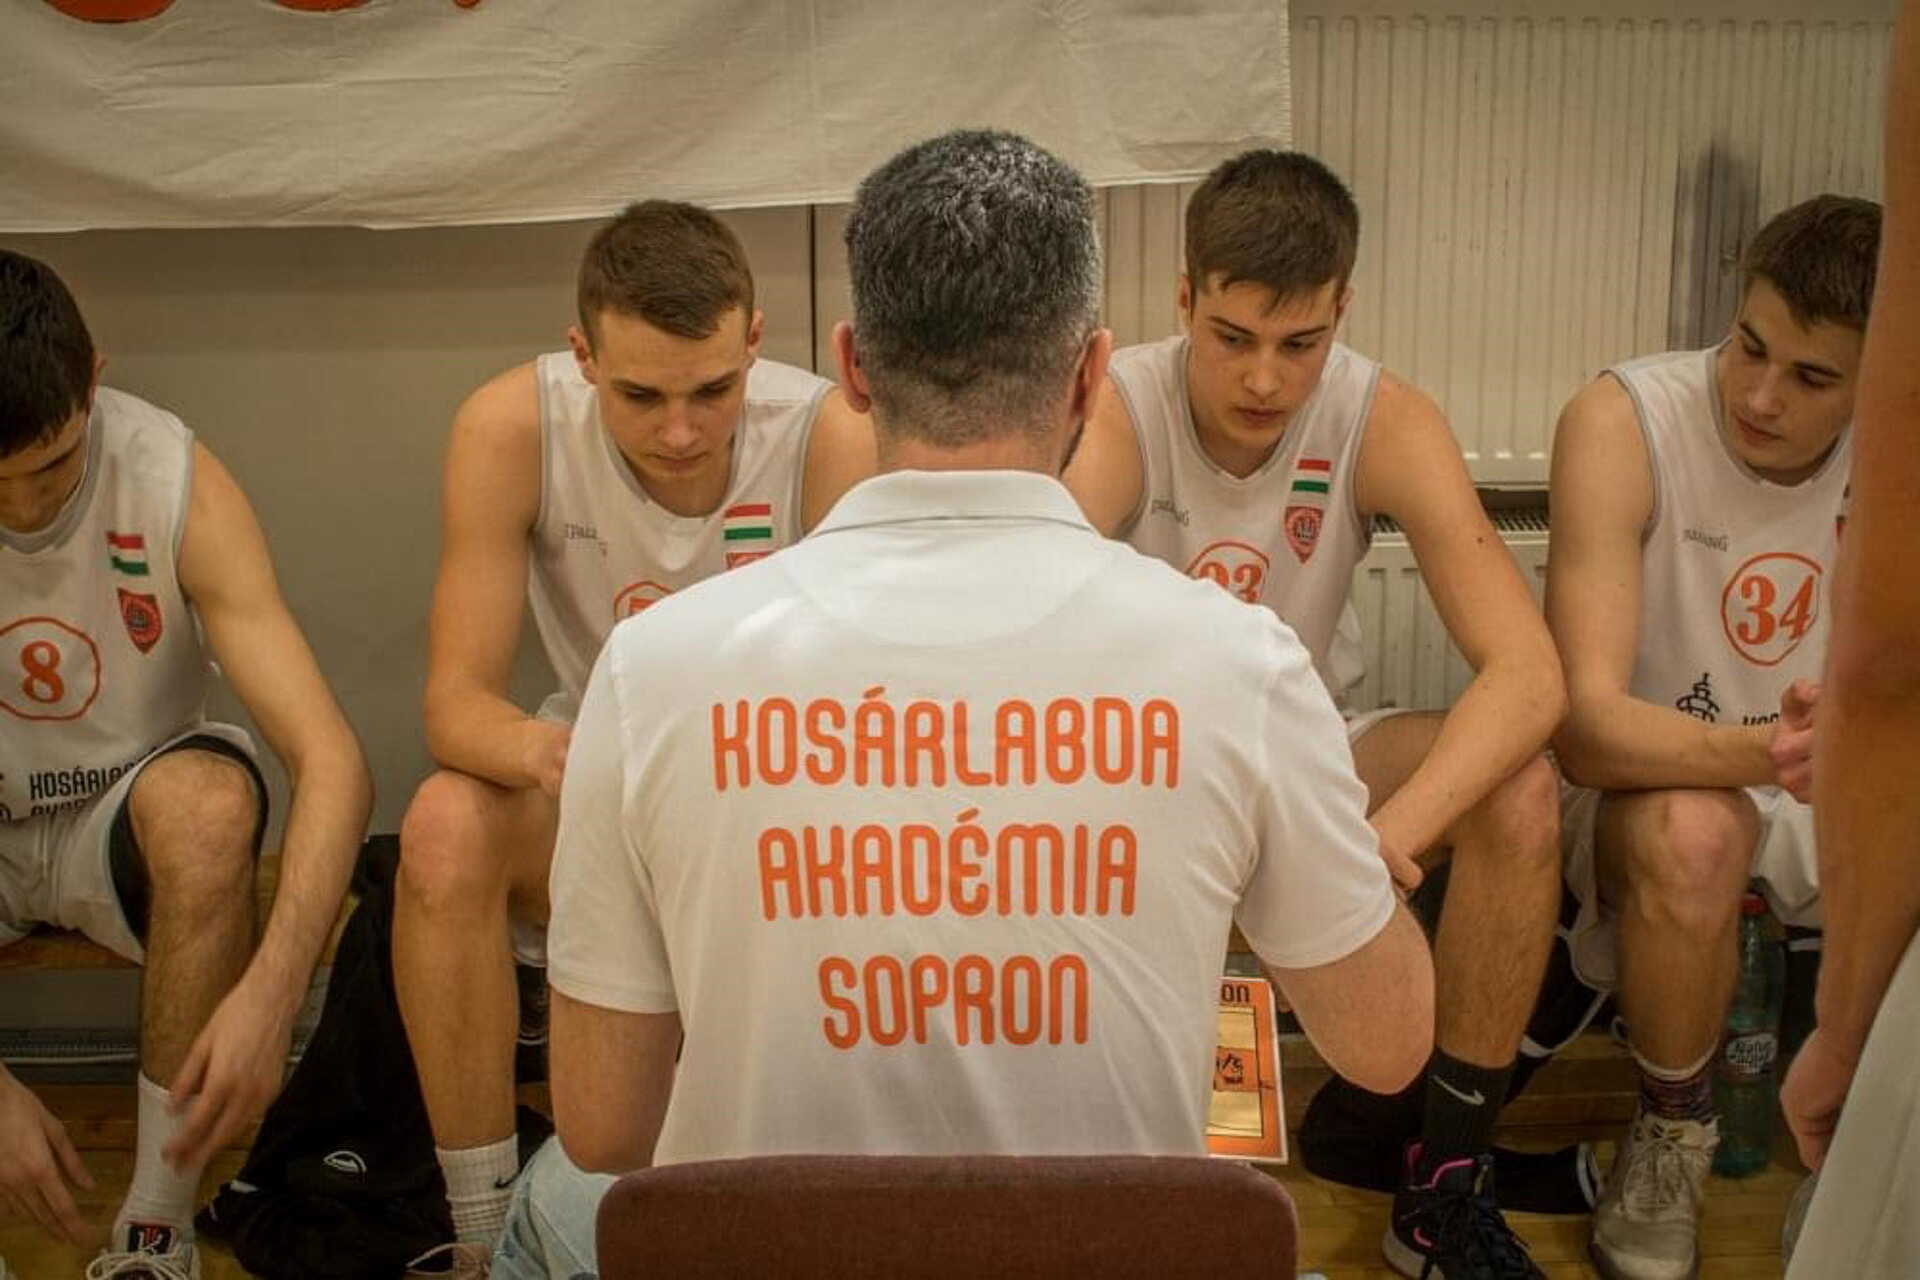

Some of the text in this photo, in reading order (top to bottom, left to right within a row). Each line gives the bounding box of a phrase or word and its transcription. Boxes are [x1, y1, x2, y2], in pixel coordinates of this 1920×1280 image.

[1736, 574, 1815, 646] 34
[20, 640, 65, 703] 8
[712, 687, 1179, 791] KOSÁRLABDA
[758, 808, 1137, 921] AKADÉMIA
[818, 954, 1089, 1049] SOPRON
